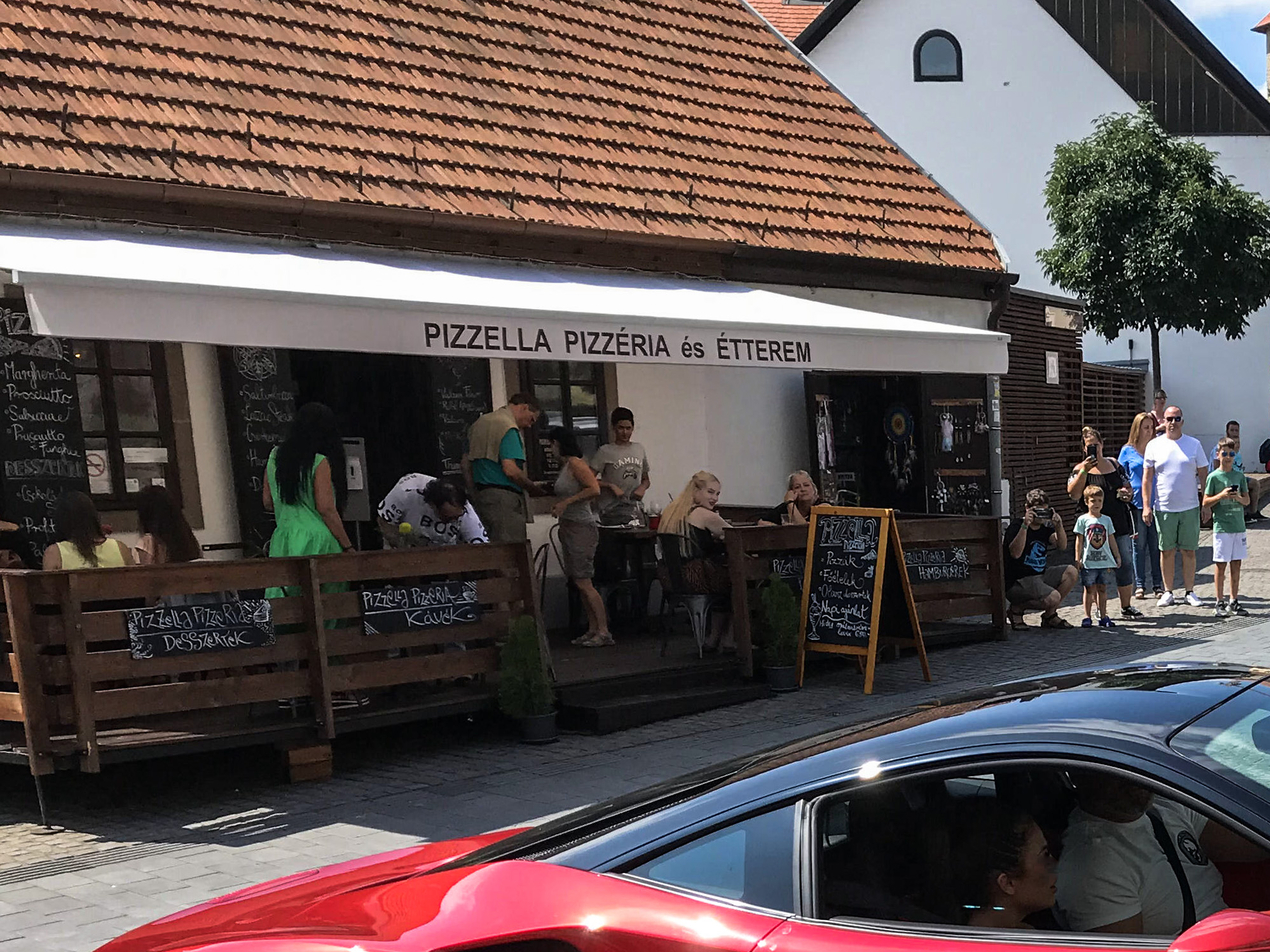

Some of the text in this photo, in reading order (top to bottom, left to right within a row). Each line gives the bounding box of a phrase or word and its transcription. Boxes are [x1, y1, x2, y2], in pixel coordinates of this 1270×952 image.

[424, 322, 812, 363] PIZZELLA PIZZÉRIA és ÉTTEREM
